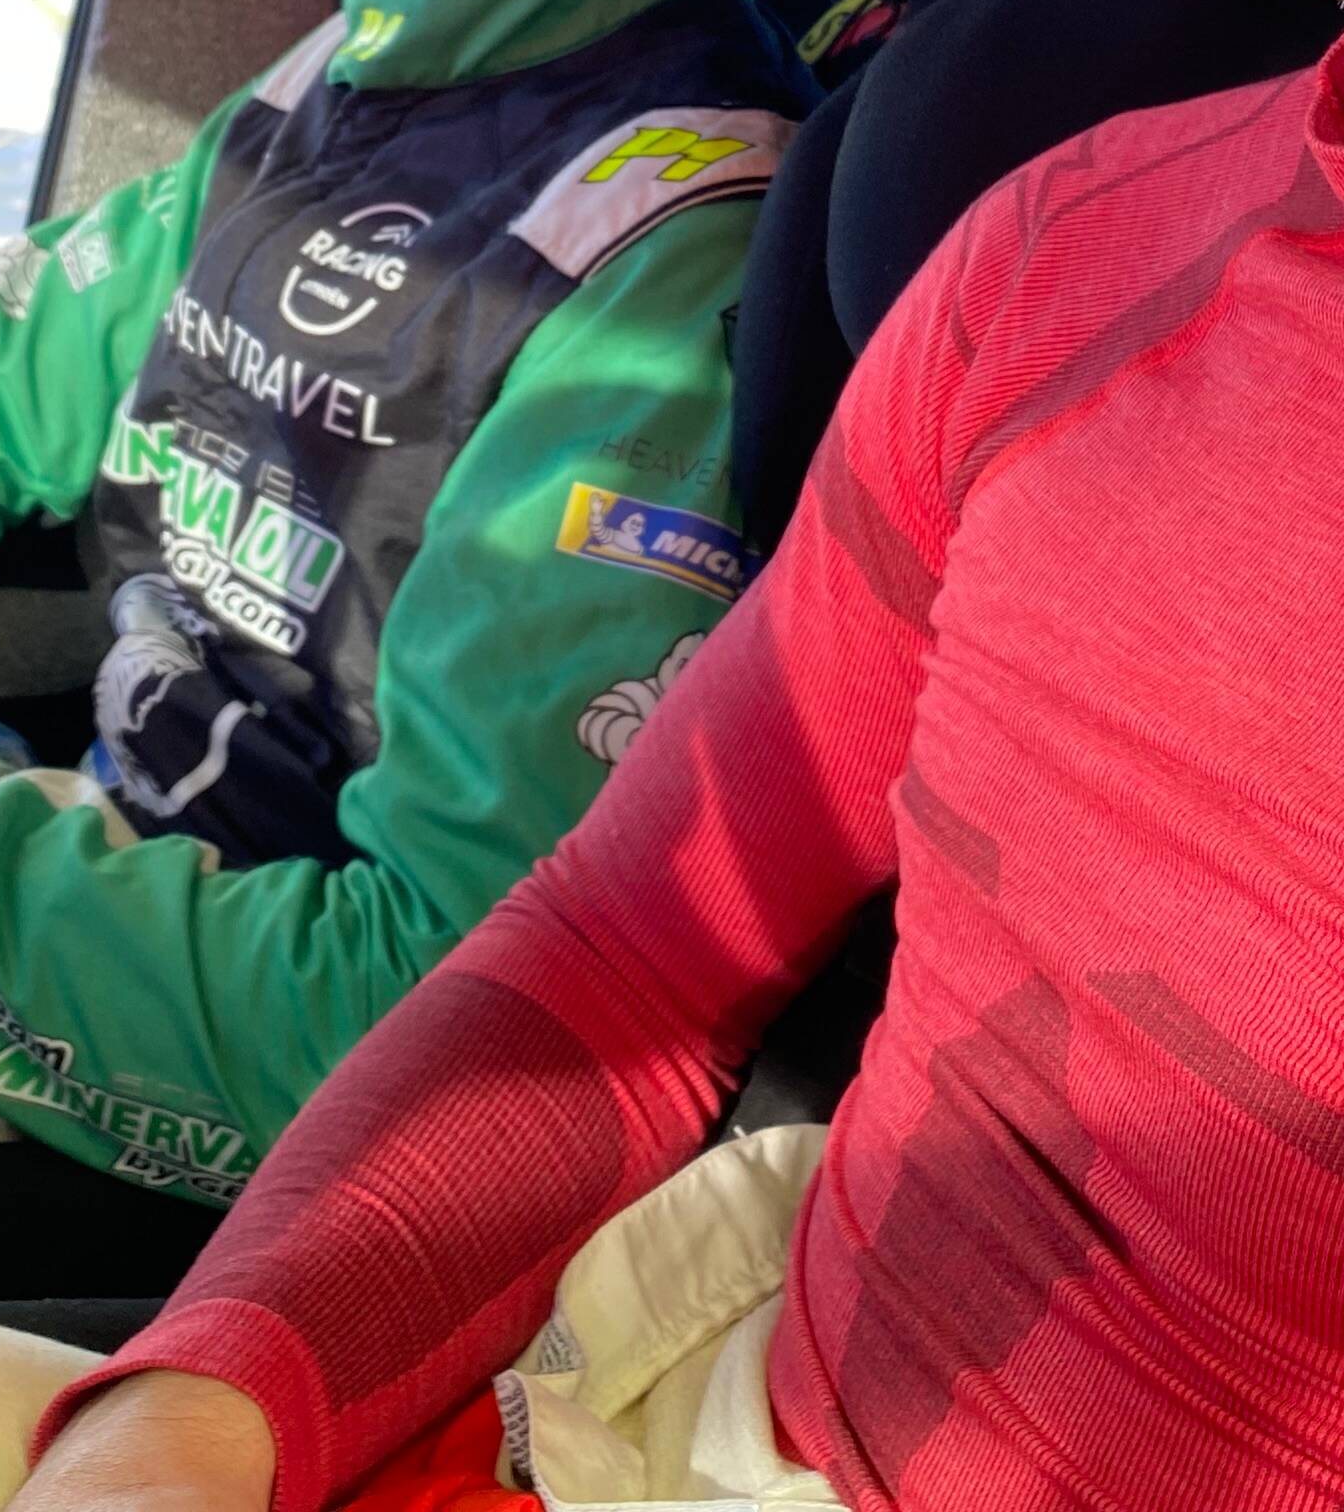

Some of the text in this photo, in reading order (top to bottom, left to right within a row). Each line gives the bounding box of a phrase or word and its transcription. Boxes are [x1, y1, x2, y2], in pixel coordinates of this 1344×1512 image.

[580, 127, 756, 183] P1
[228, 324, 397, 447] TRAVEL
[241, 508, 330, 606] OIL
[123, 1147, 179, 1185] by
